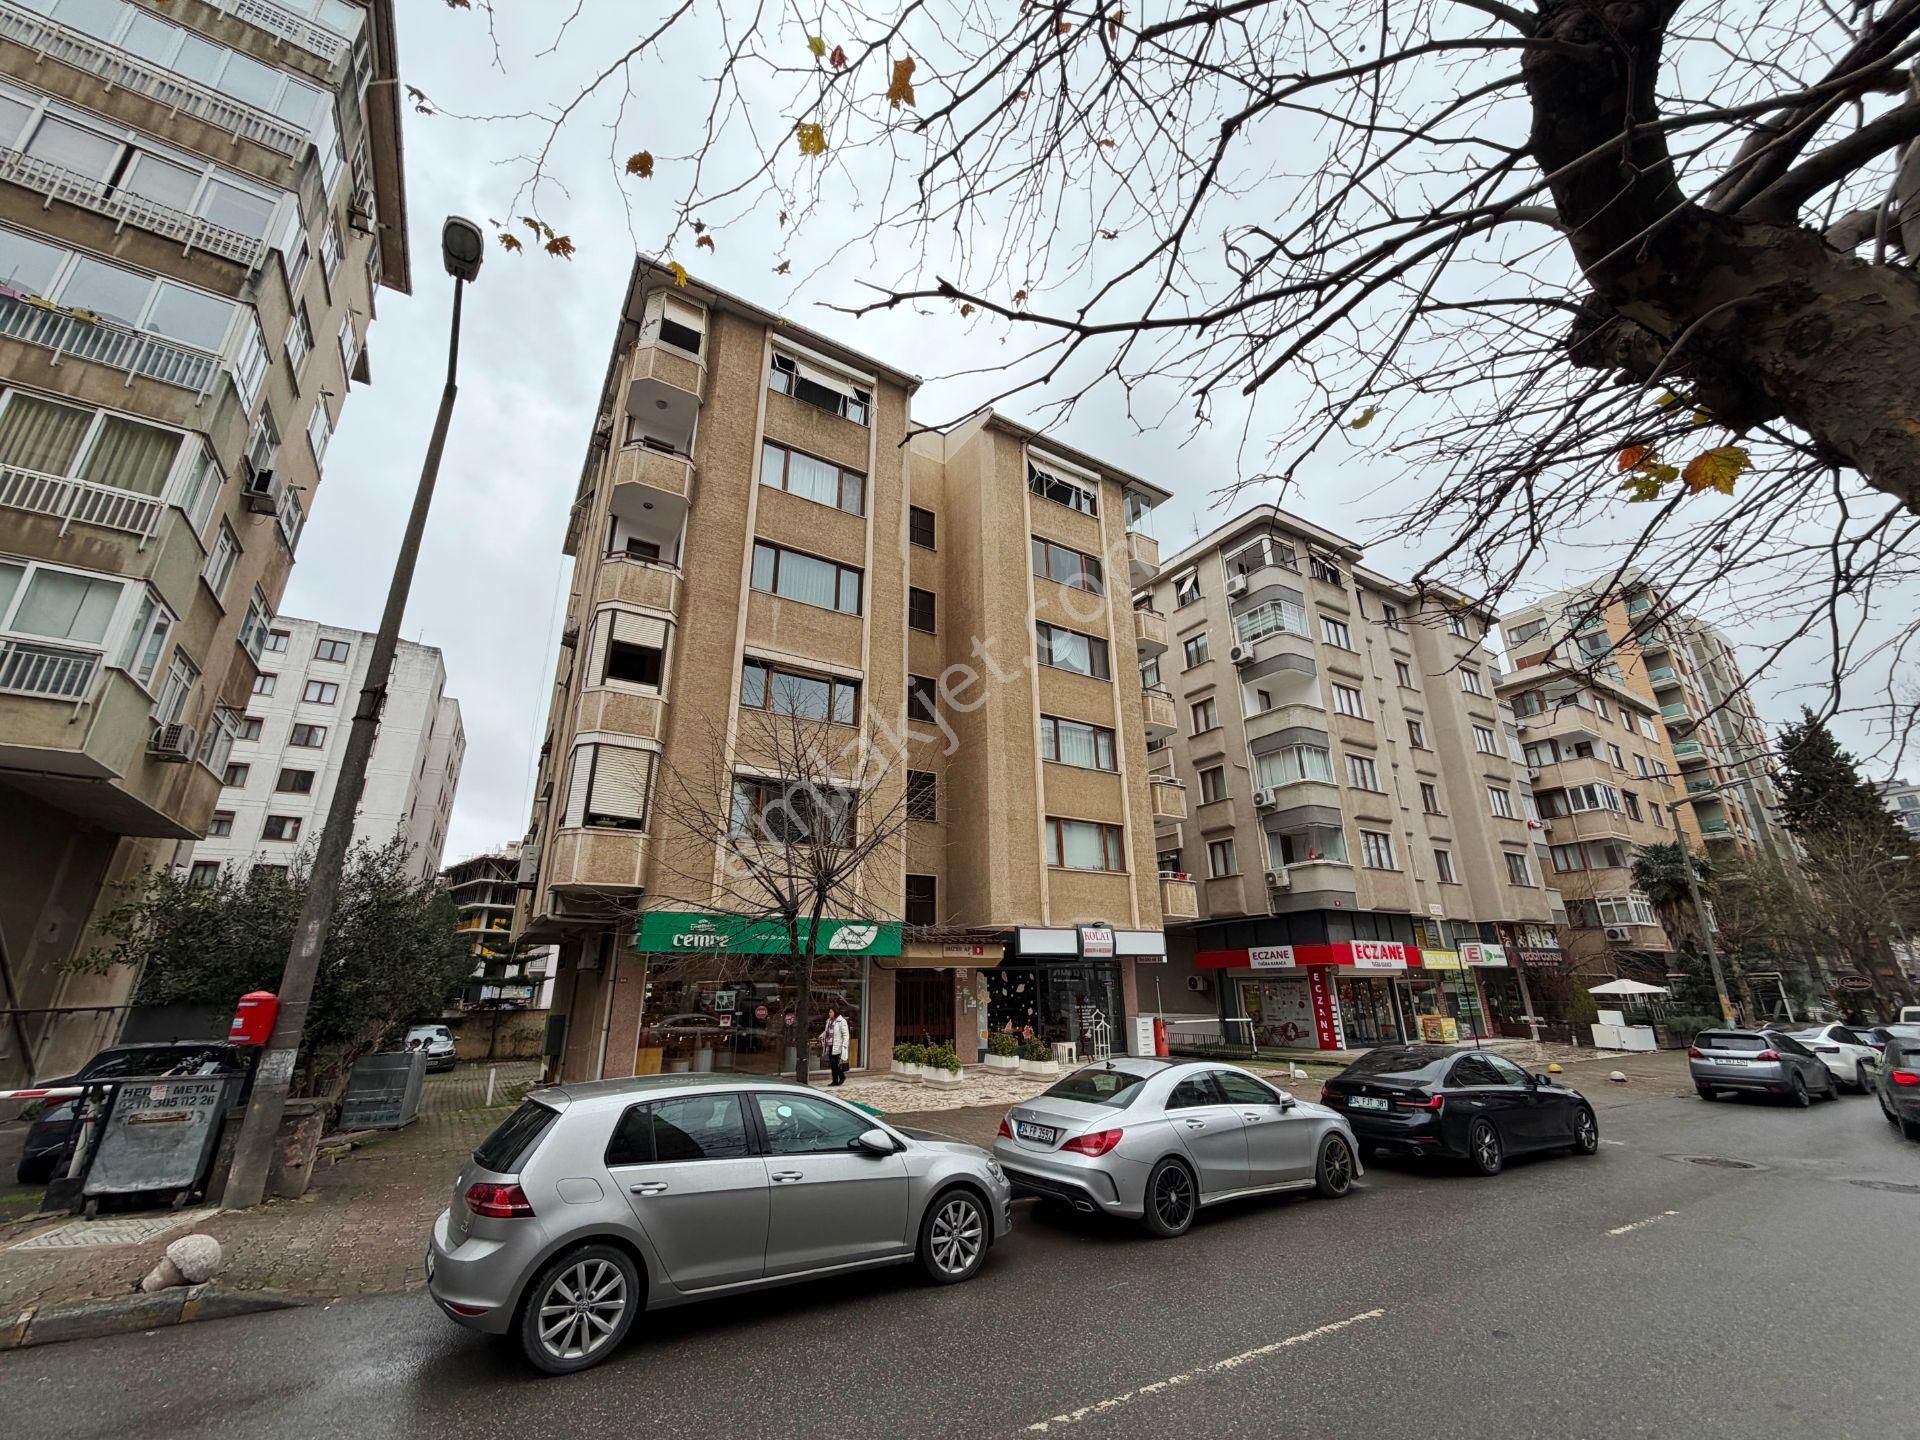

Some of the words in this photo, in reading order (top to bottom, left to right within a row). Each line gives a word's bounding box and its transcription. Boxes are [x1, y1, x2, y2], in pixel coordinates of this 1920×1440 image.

[672, 933, 730, 947] cemre
[1083, 930, 1111, 942] KOLAT
[1252, 949, 1290, 961] ECZANE
[1355, 943, 1404, 960] ECZANE
[1467, 948, 1480, 960] E
[1313, 972, 1330, 1042] ECZANE
[173, 1084, 218, 1095] METAL
[153, 1098, 178, 1109] 305
[1021, 1121, 1029, 1133] 34
